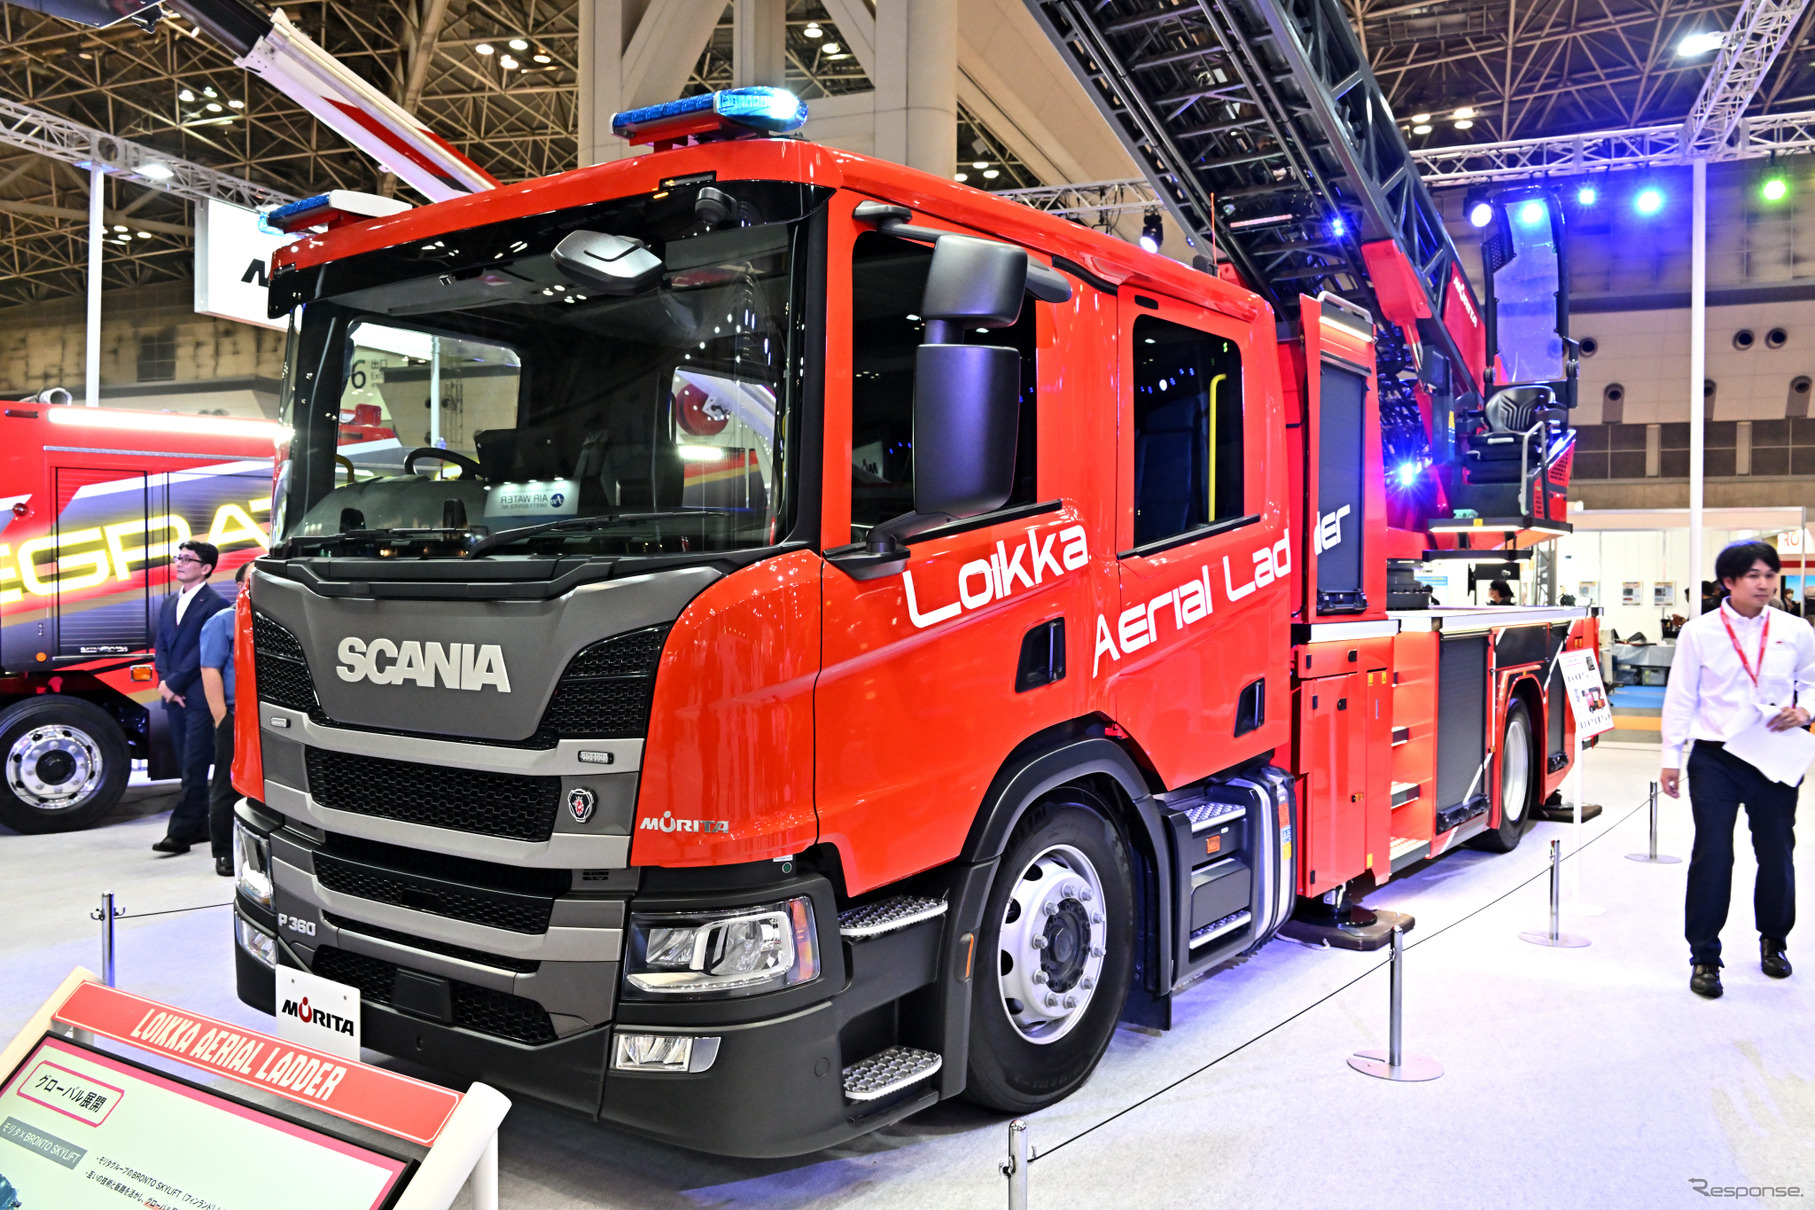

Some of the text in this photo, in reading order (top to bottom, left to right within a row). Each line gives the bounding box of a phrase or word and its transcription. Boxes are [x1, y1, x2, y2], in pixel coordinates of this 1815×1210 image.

[351, 359, 366, 389] 6
[902, 525, 1090, 629] Loikka
[1093, 564, 1213, 679] Aerial
[336, 636, 511, 693] SCANIA
[640, 810, 729, 834] MORITA
[278, 913, 317, 937] P 360
[281, 996, 354, 1037] MORITA
[130, 1008, 348, 1102] LOIKKA AERIAL LADDER
[35, 1074, 107, 1113] グローバル展開
[50, 1144, 82, 1163] SKYLIFT
